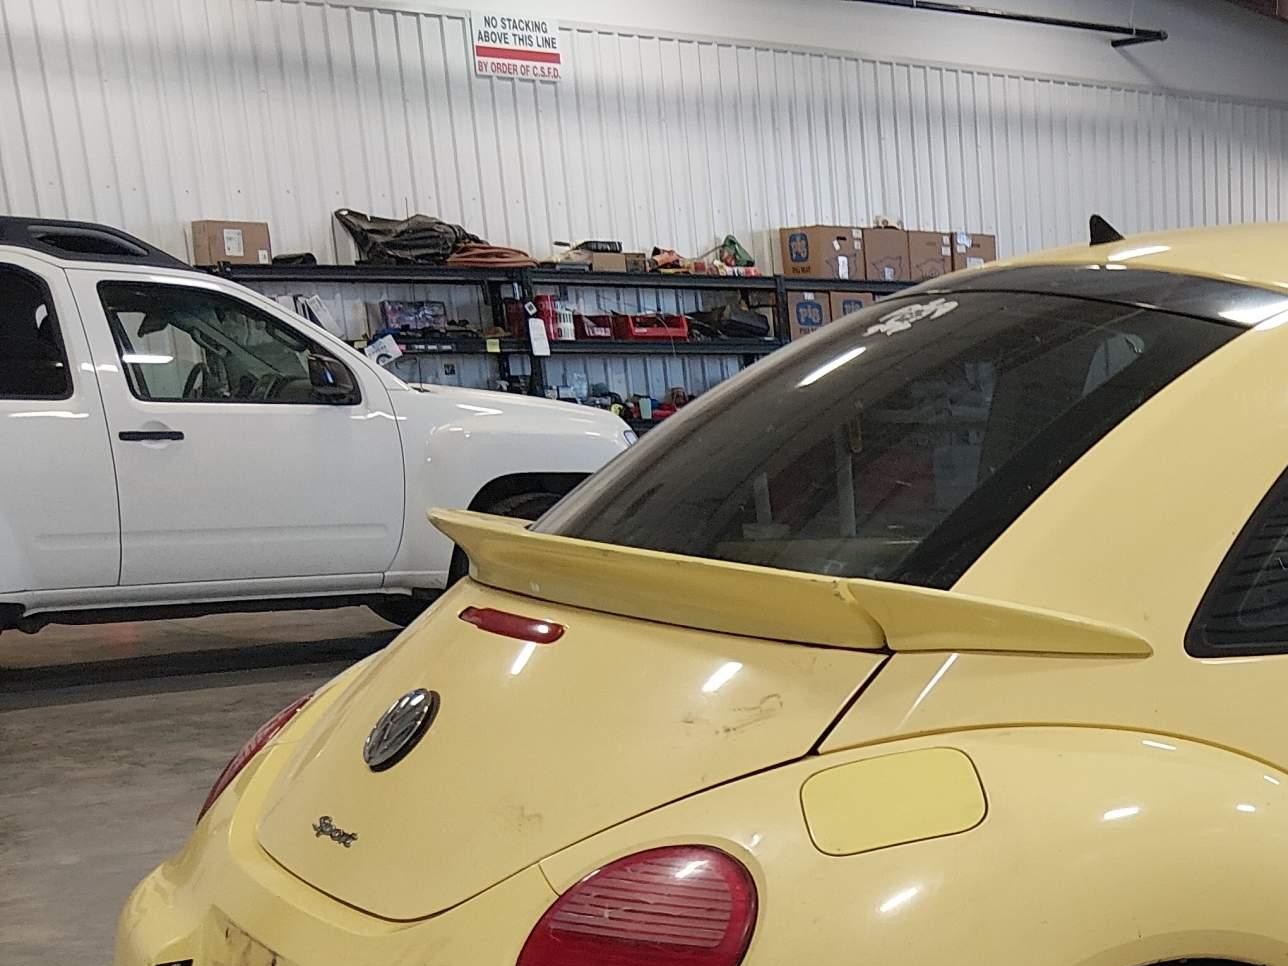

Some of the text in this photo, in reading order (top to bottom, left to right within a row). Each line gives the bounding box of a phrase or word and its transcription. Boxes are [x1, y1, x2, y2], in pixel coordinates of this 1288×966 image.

[484, 15, 548, 34] NO STACKING
[477, 30, 557, 49] ABOVE THIS LINE
[477, 60, 562, 79] BY ORDER OF C.S.F.D.
